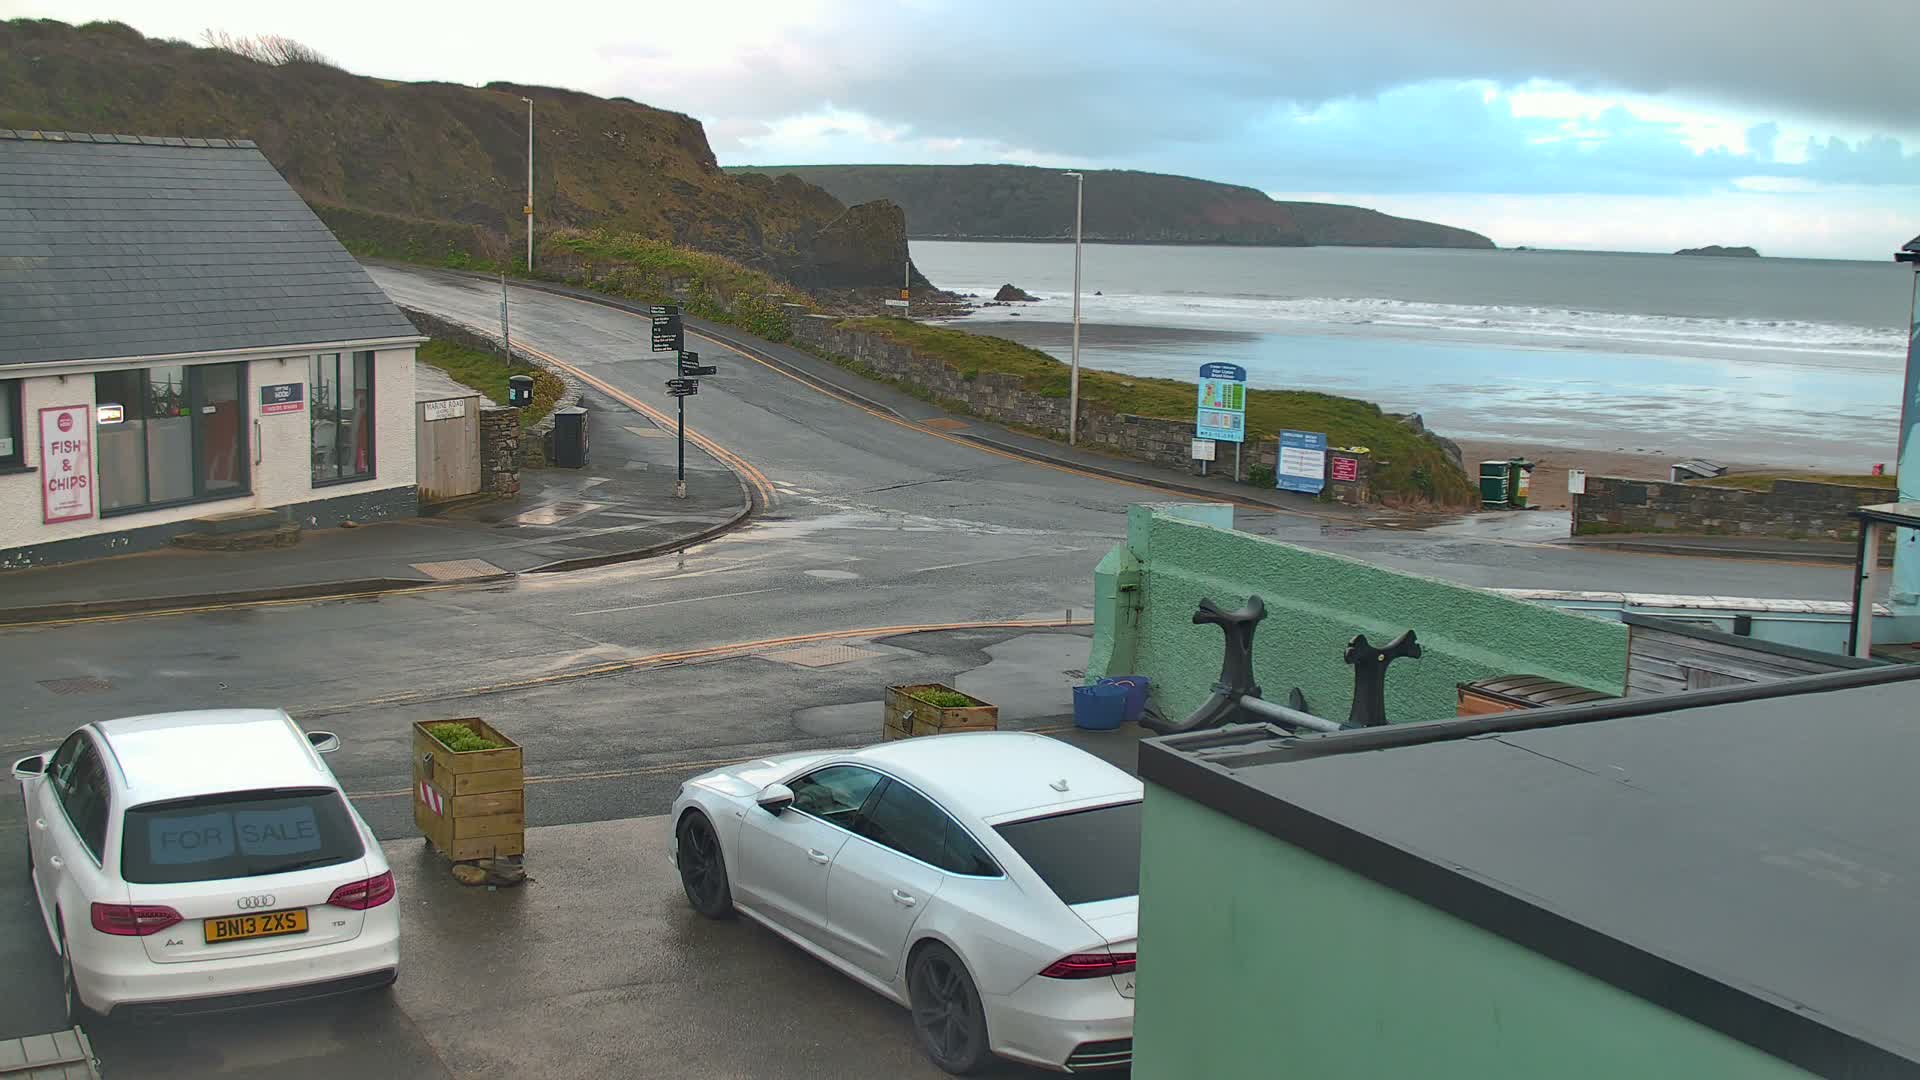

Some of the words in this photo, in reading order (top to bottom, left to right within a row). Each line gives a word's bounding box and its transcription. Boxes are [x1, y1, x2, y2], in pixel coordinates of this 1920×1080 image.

[449, 400, 464, 408] ROAD
[51, 440, 81, 456] FISH
[62, 459, 72, 472] &
[49, 475, 87, 492] CHIPS
[161, 828, 223, 849] FOR
[241, 820, 314, 843] SALE
[215, 917, 257, 938] BN13
[261, 912, 297, 932] ZXS
[165, 938, 184, 947] A4
